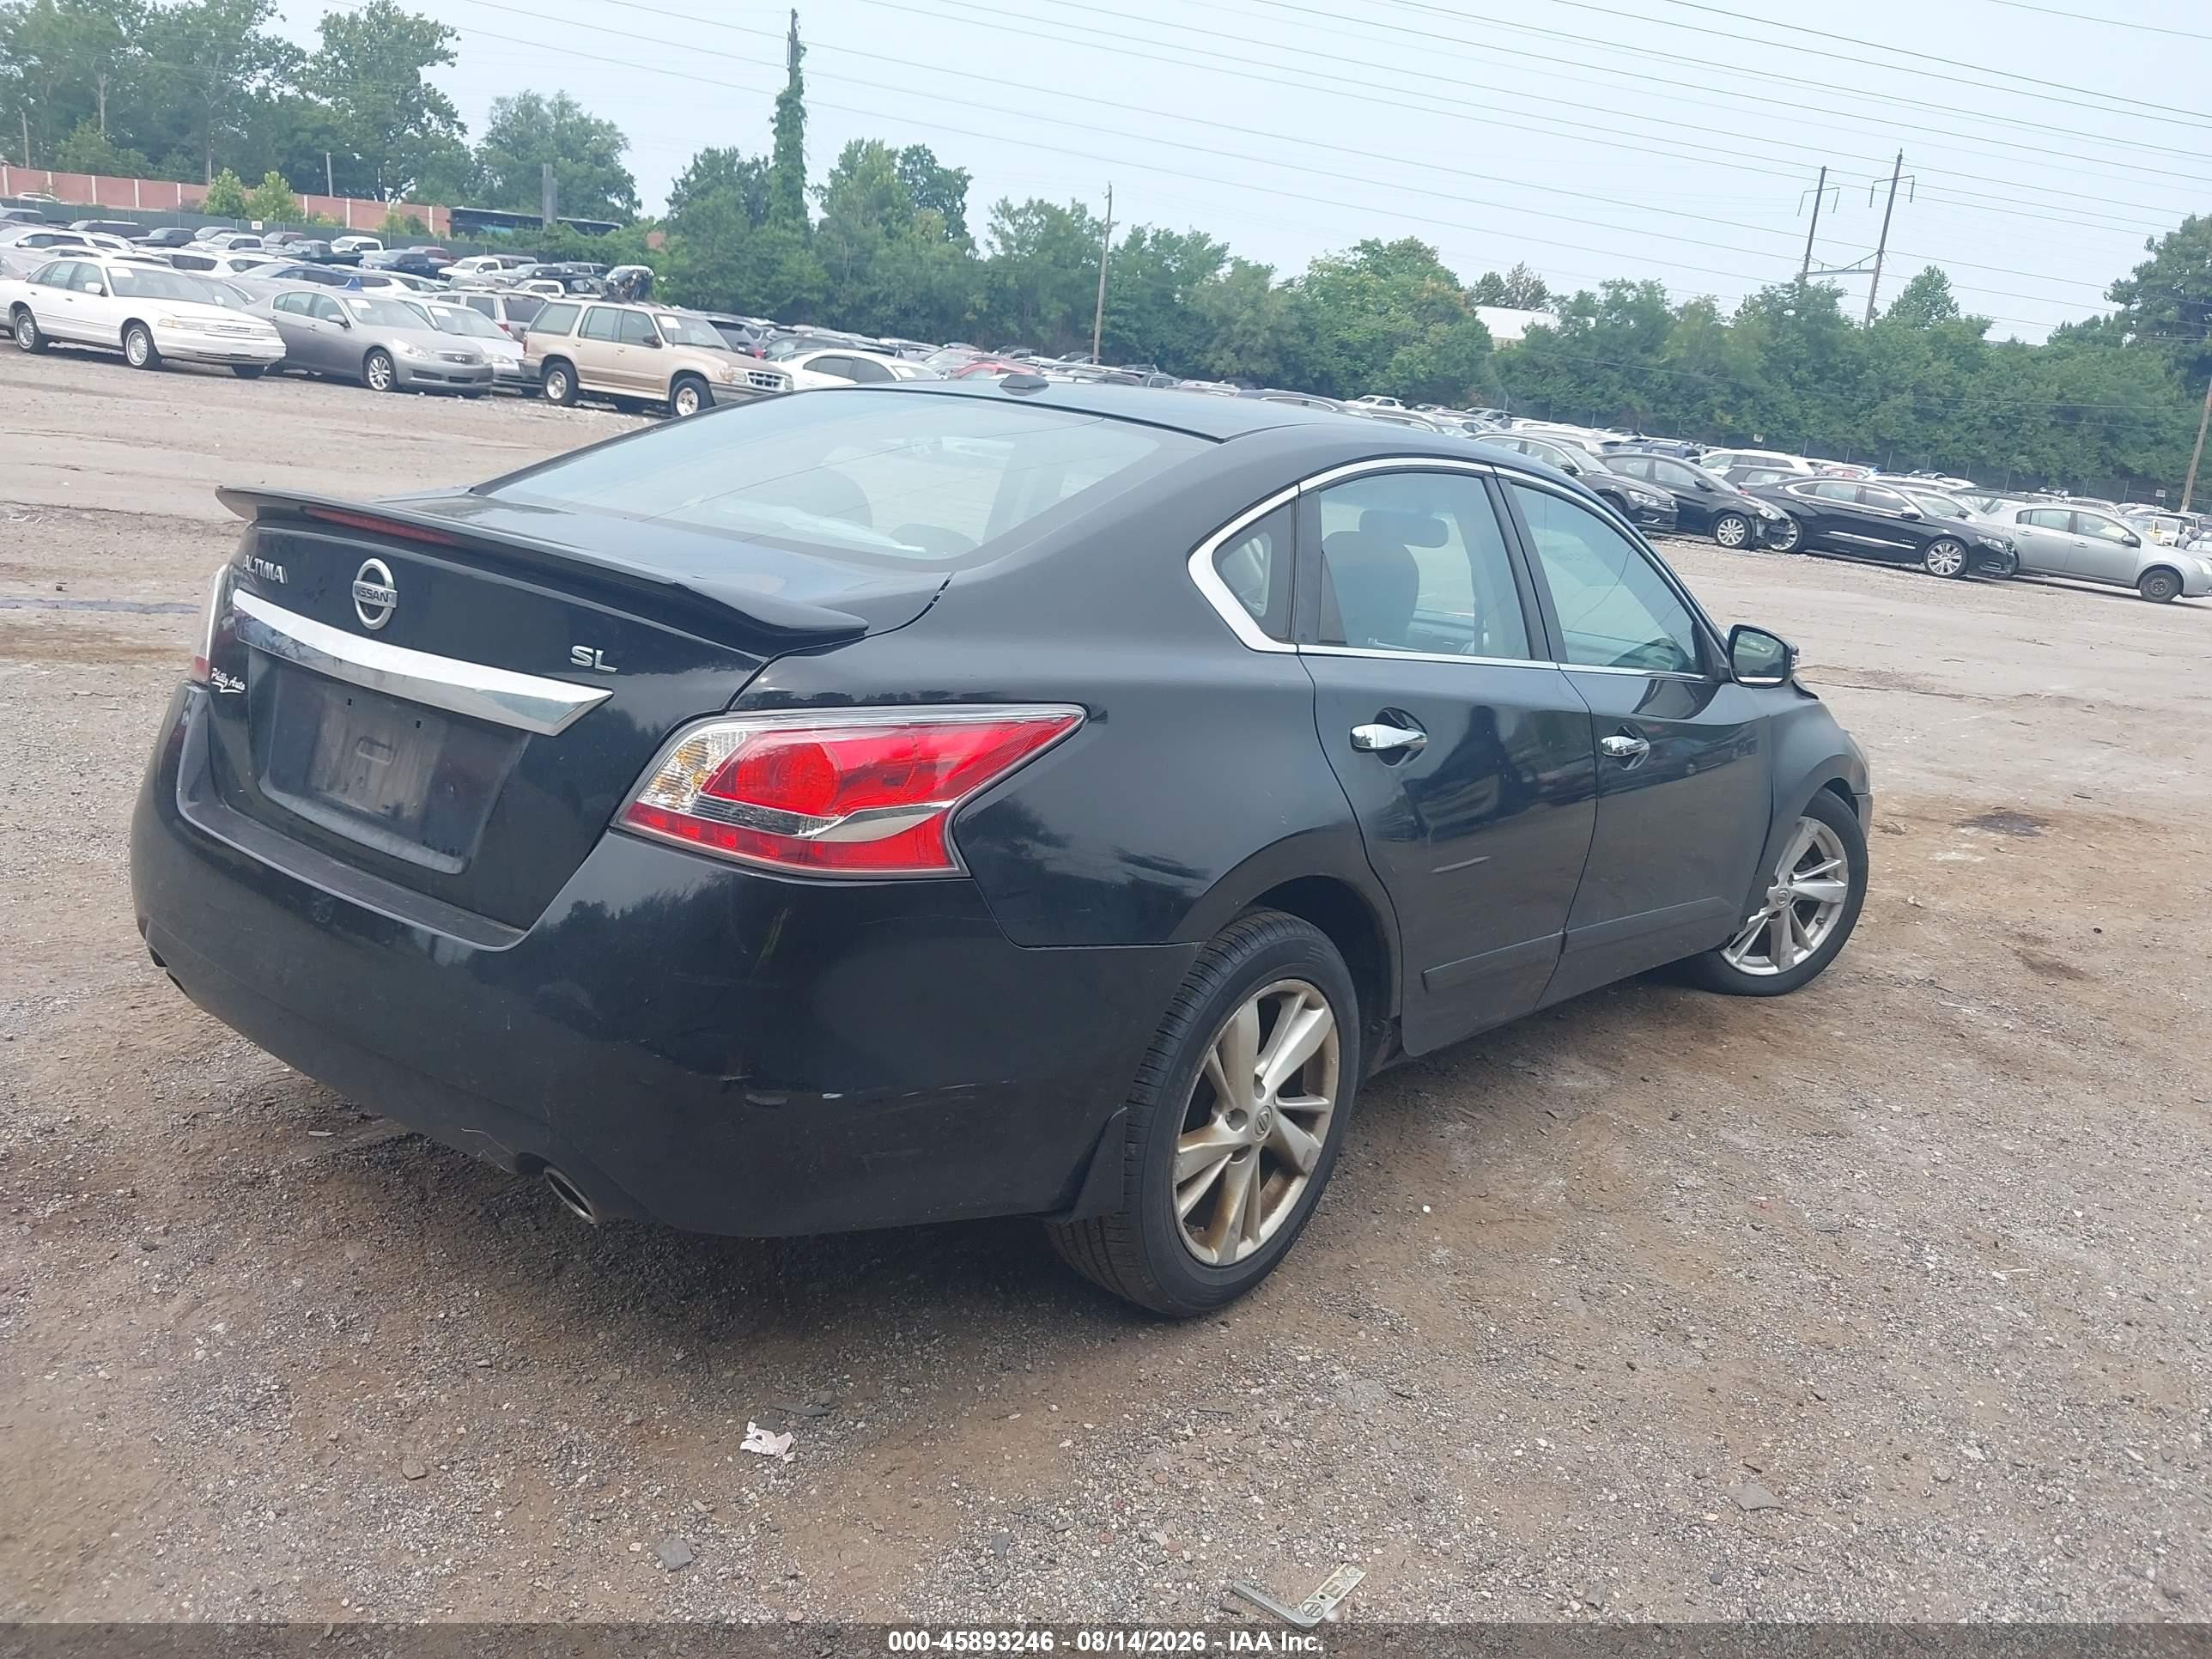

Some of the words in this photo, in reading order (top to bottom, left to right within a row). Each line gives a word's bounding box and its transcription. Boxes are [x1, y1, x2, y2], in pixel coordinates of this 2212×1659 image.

[242, 555, 285, 584] ALTIMA
[355, 586, 389, 603] NISSAN
[570, 646, 618, 672] SL
